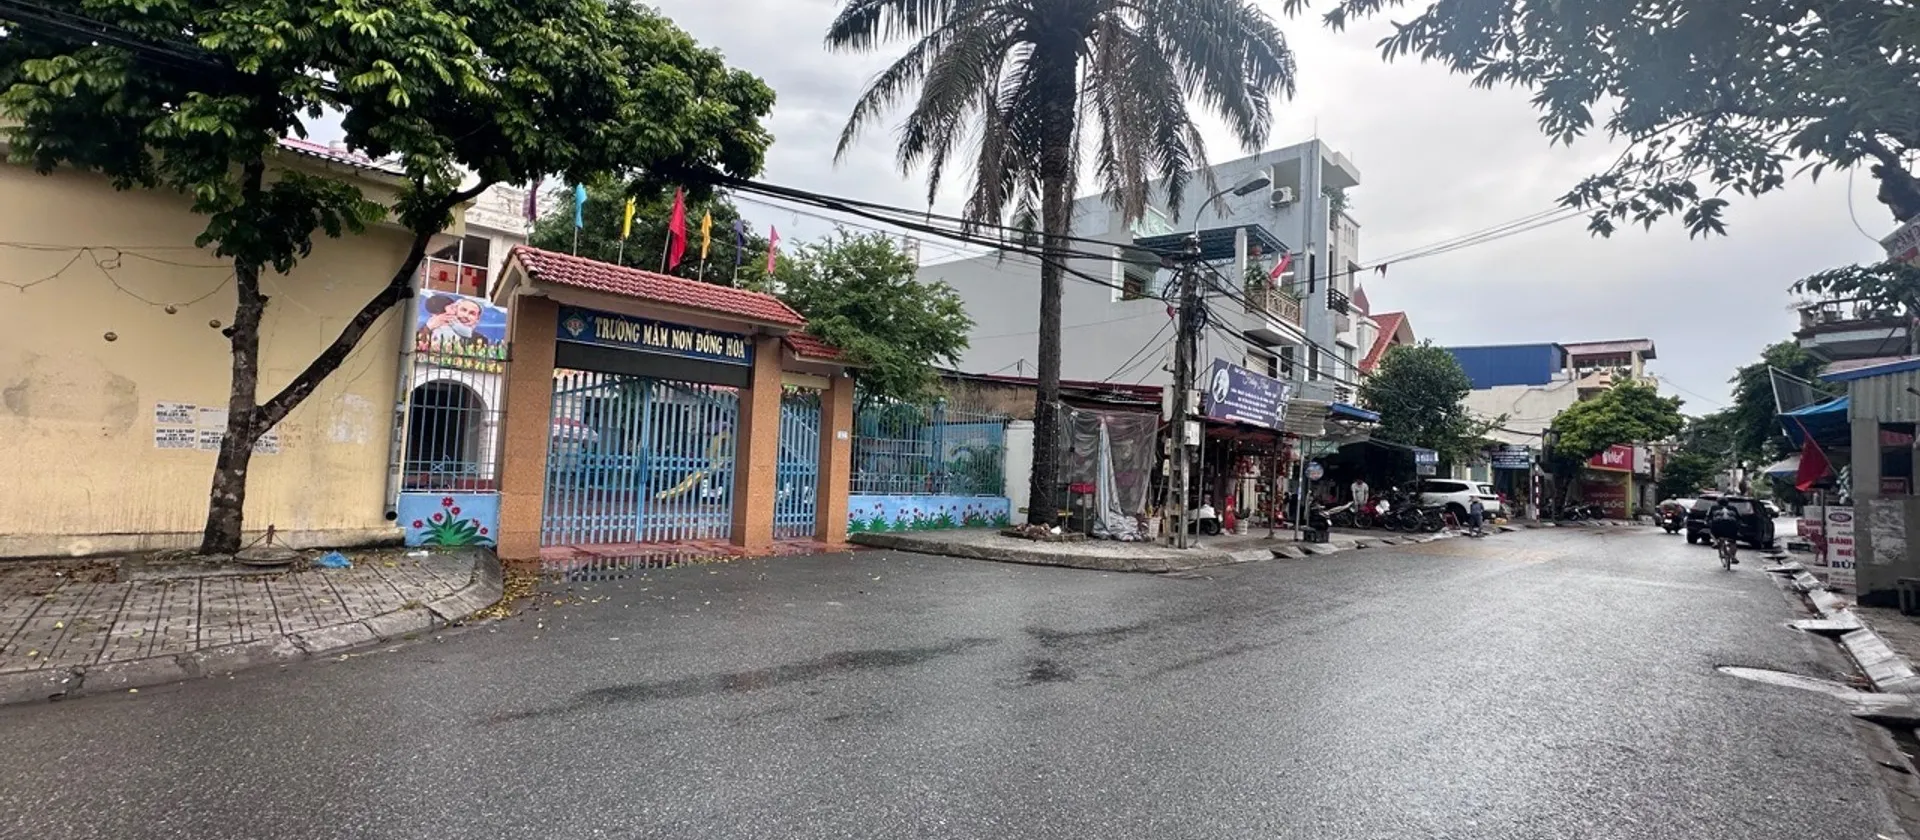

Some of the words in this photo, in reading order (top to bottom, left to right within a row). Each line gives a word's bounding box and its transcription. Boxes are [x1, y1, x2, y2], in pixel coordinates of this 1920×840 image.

[594, 314, 640, 343] TRƯỜNG
[642, 321, 669, 347] MẦM
[671, 329, 693, 351] NON
[726, 334, 746, 358] HÒA
